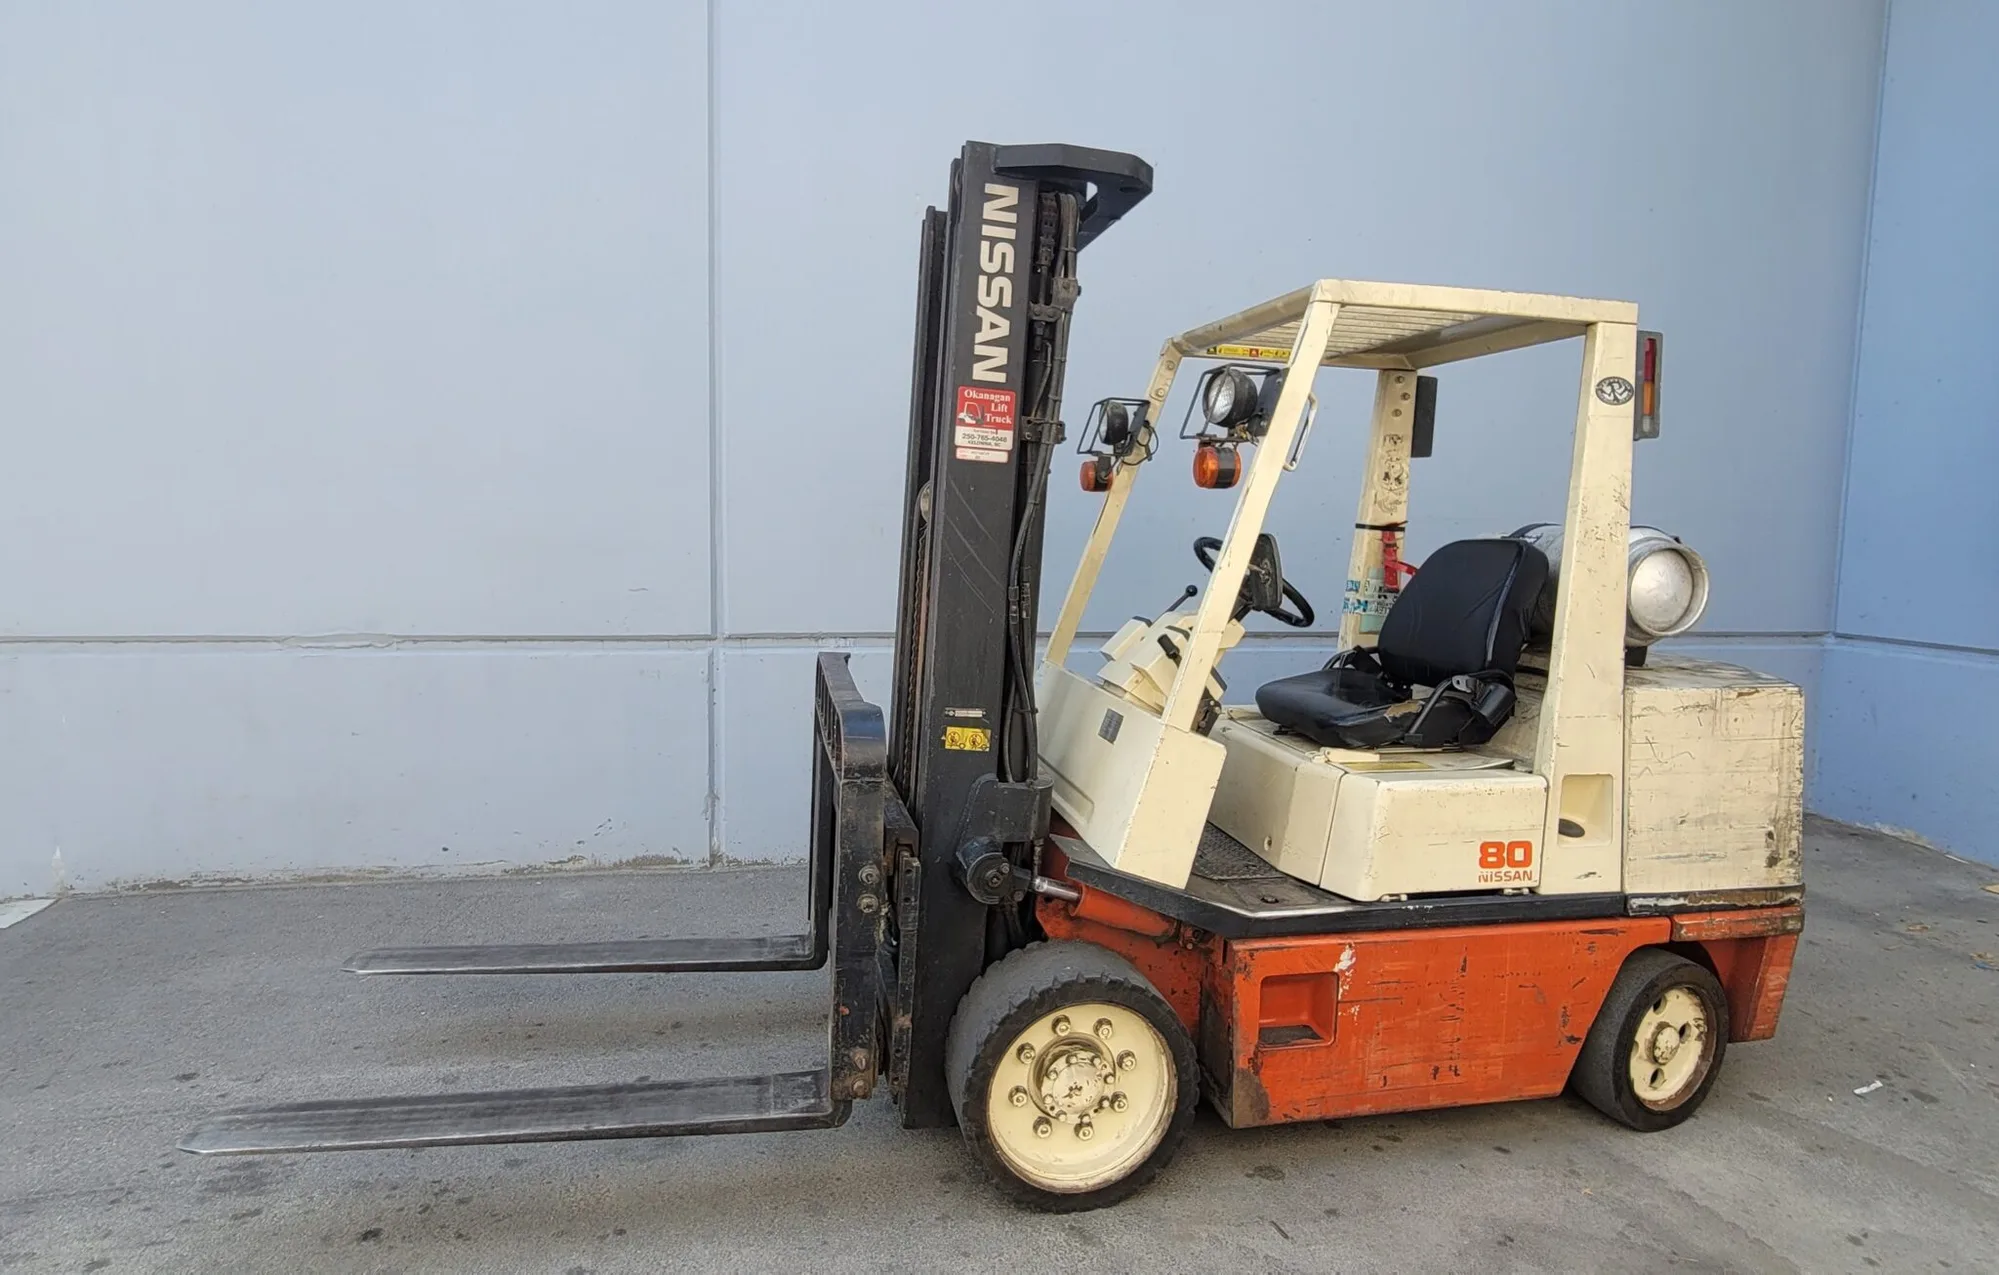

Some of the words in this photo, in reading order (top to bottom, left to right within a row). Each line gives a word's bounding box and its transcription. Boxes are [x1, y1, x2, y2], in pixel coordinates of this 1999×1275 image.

[972, 183, 1019, 383] NISSAN
[964, 389, 1011, 402] Okanagan
[991, 403, 1008, 412] Lift
[984, 413, 1012, 424] Truck
[1479, 841, 1532, 868] 80
[1478, 870, 1533, 883] NISSAN
